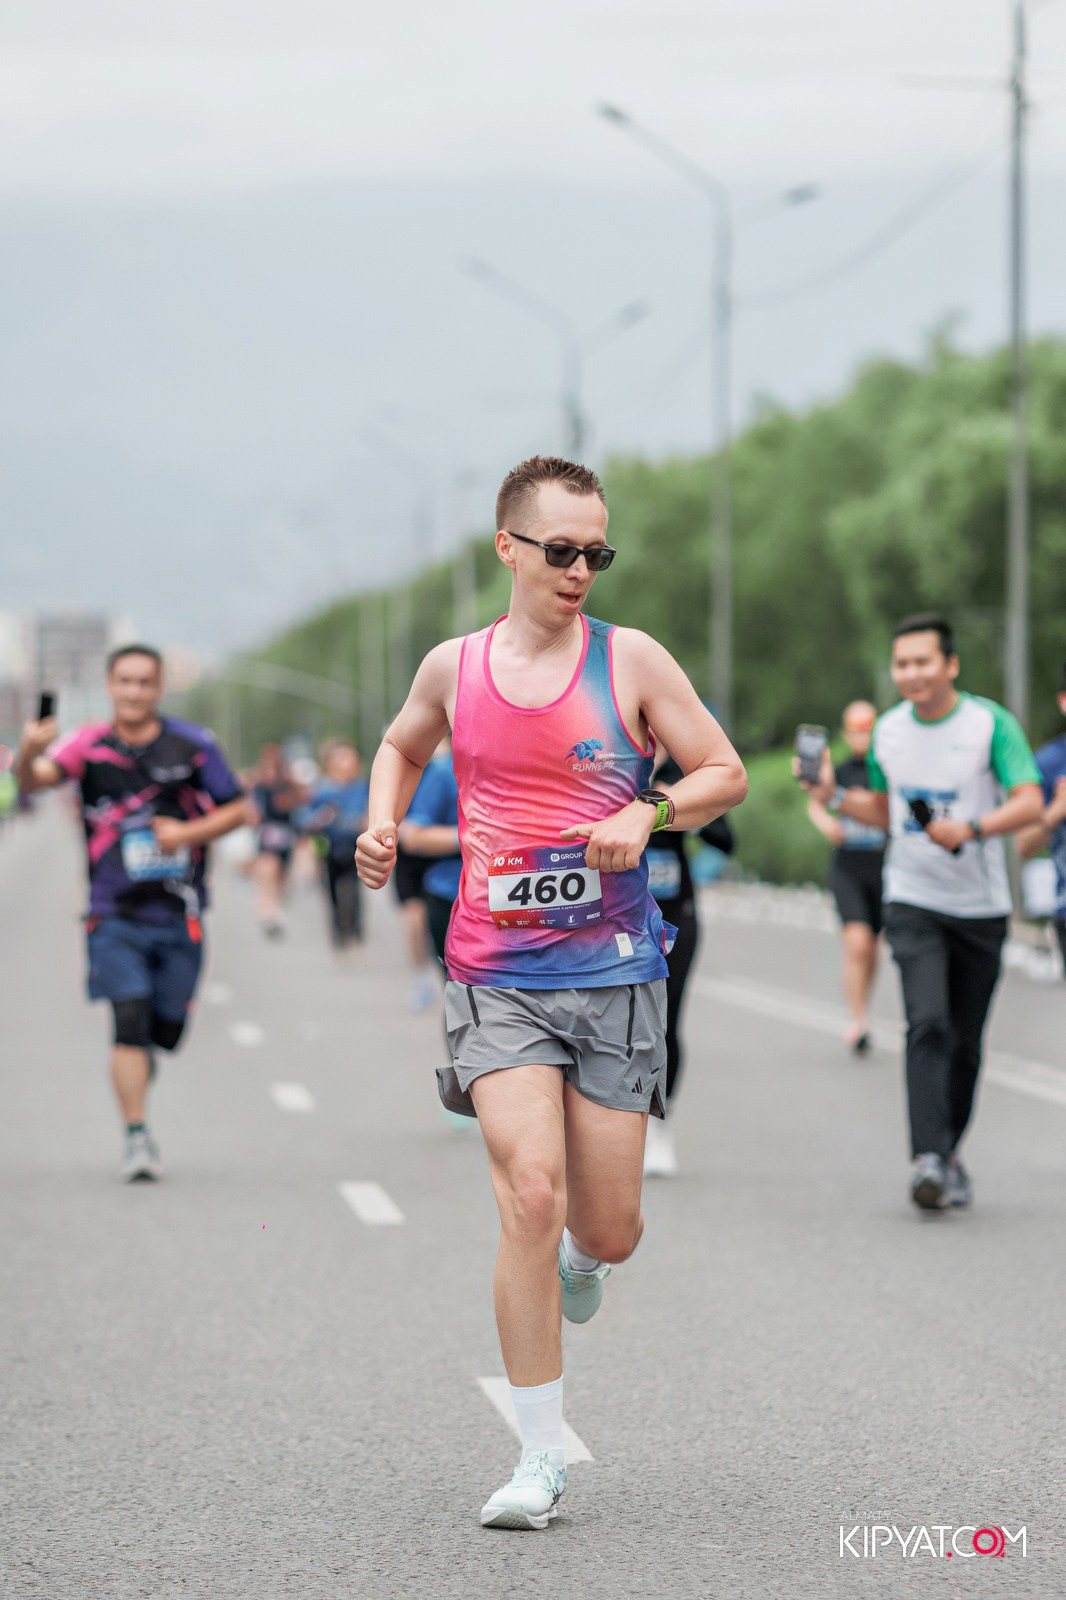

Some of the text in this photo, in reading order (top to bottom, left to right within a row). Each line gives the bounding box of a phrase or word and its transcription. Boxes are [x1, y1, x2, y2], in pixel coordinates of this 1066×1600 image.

[572, 760, 615, 772] RUNNERS
[493, 856, 523, 867] 10 KM
[560, 852, 583, 860] GROUP
[507, 872, 586, 906] 460
